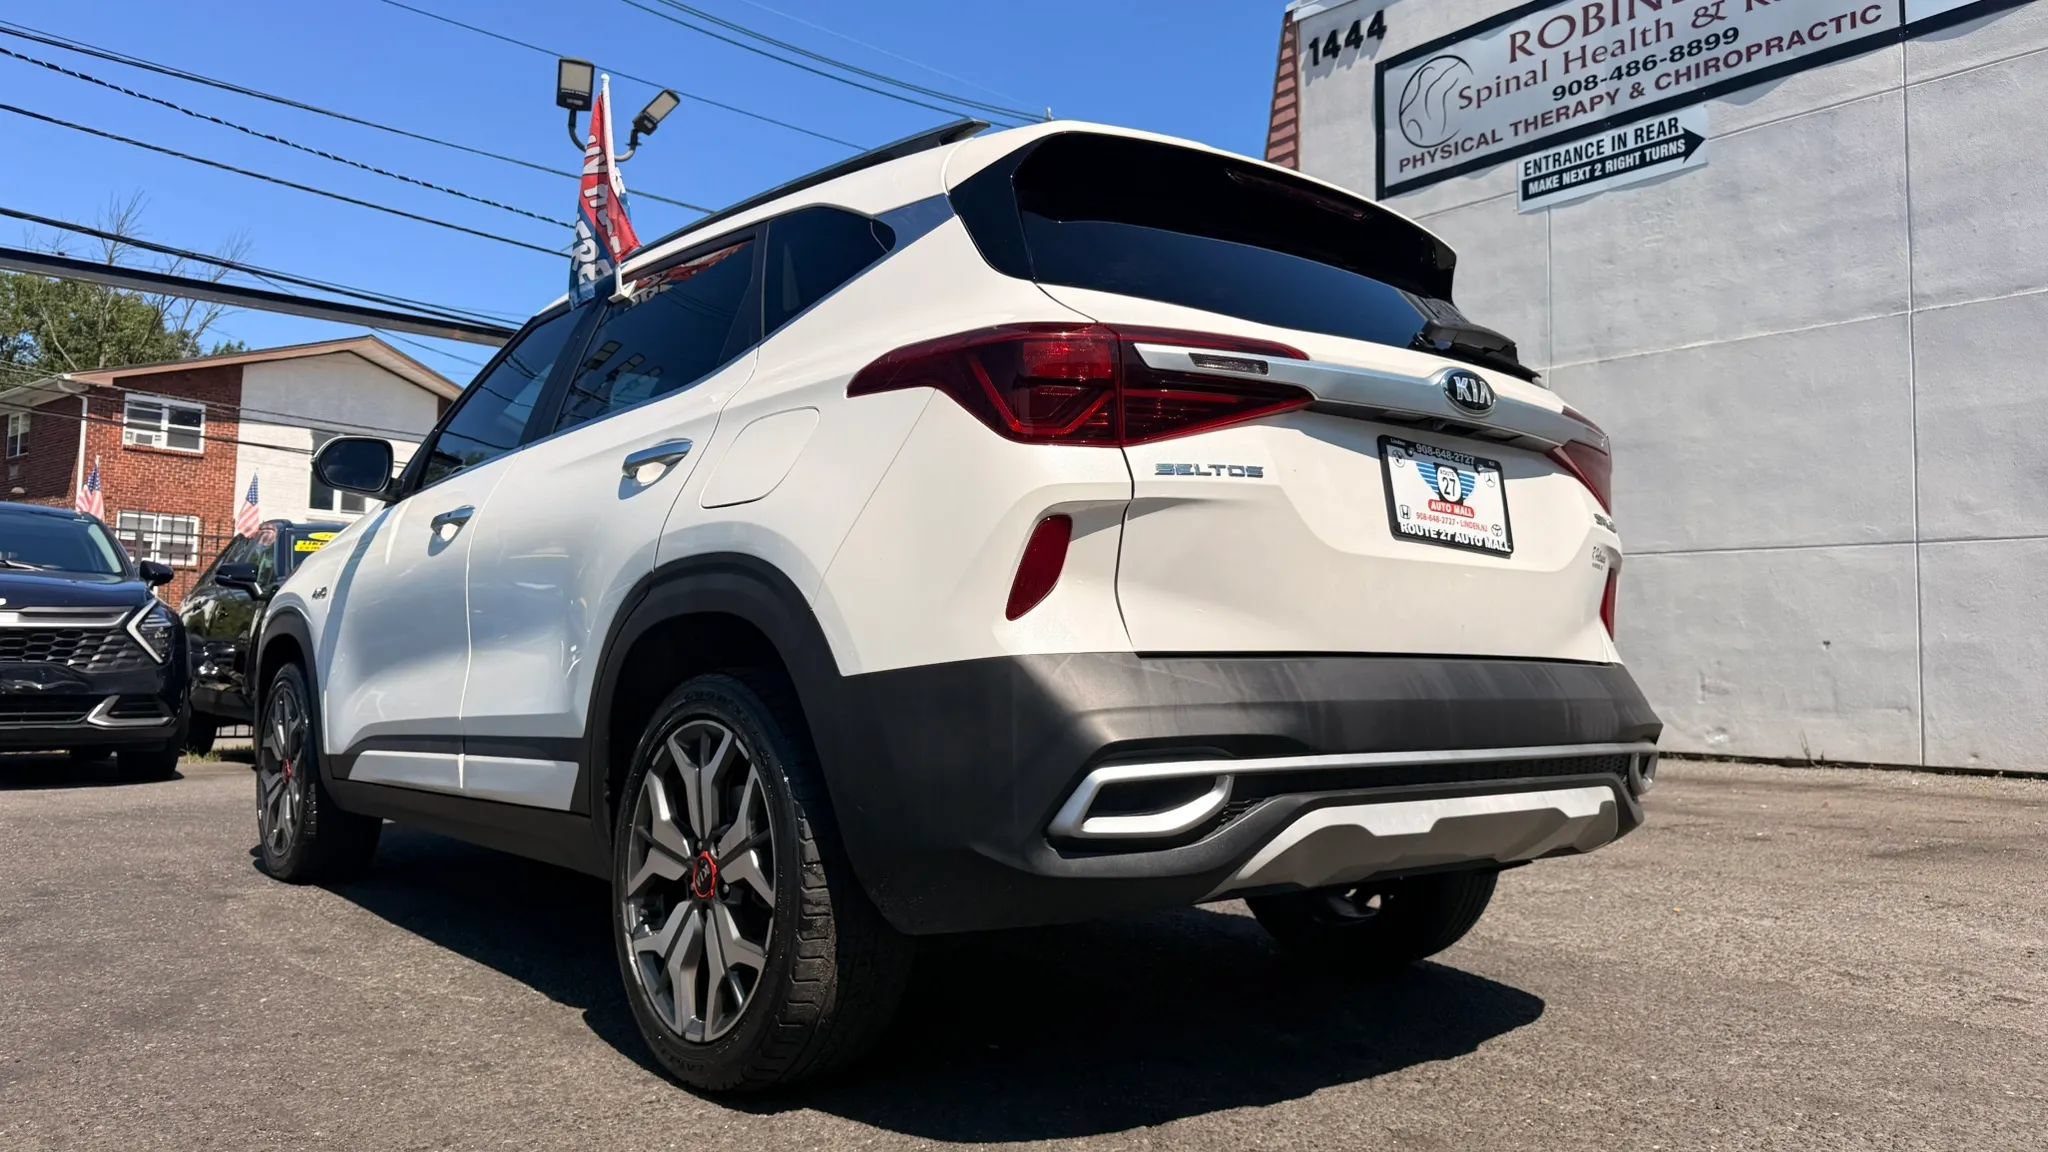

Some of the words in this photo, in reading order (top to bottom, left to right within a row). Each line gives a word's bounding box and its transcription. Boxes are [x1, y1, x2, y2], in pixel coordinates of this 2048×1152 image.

[1309, 10, 1387, 66] 1444
[1458, 59, 1548, 109] Spinal
[1563, 18, 1674, 75] Health
[1691, 0, 1728, 30] &
[1552, 27, 1739, 101] 908-486-8899
[1399, 129, 1503, 173] PHYSICAL
[1510, 88, 1620, 137] THERAPY
[1629, 81, 1645, 99] &
[1654, 4, 1882, 91] CHIROPRACTIC
[1524, 138, 1605, 177] ENTRANCE
[1611, 132, 1627, 152] IN
[1634, 116, 1679, 145] REAR
[1528, 175, 1560, 195] MAKE
[1562, 166, 1591, 185] NEXT
[1594, 163, 1602, 176] 2
[1605, 152, 1641, 174] RIGHT
[1644, 139, 1686, 162] TURNS
[1453, 376, 1491, 405] KIA
[1154, 463, 1263, 478] SELTOS
[1415, 443, 1475, 465] 908-648-2727
[1441, 476, 1456, 497] 27
[1430, 501, 1452, 513] AUTO
[1454, 504, 1474, 517] MALL
[1400, 522, 1438, 539] ROUTE
[1438, 528, 1453, 541] 27
[1454, 532, 1483, 546] AUTO
[1485, 537, 1512, 552] MALL
